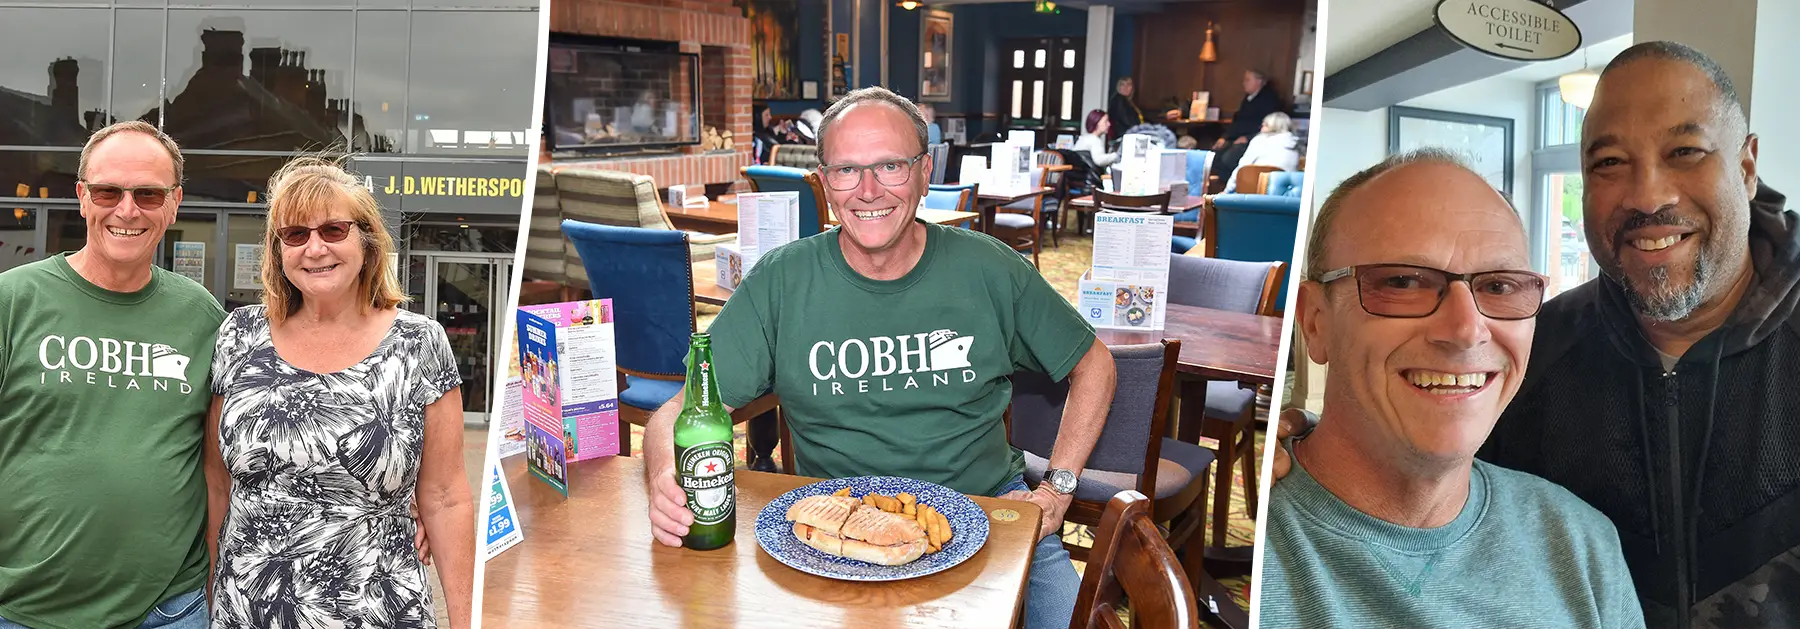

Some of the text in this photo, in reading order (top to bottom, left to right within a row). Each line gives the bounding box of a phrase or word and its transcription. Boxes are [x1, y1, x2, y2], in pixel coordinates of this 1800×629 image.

[1467, 2, 1561, 34] ACCESSIBLE
[1485, 21, 1543, 45] TOILET
[1096, 215, 1145, 225] BREAKFAST
[38, 334, 152, 377] COBH
[808, 332, 931, 381] COBH
[40, 371, 193, 395] IRELAND
[701, 371, 710, 408] Heineken
[812, 369, 977, 396] IRELAND
[683, 472, 734, 489] Heineken
[688, 500, 702, 515] PURE
[702, 509, 720, 517] MALT
